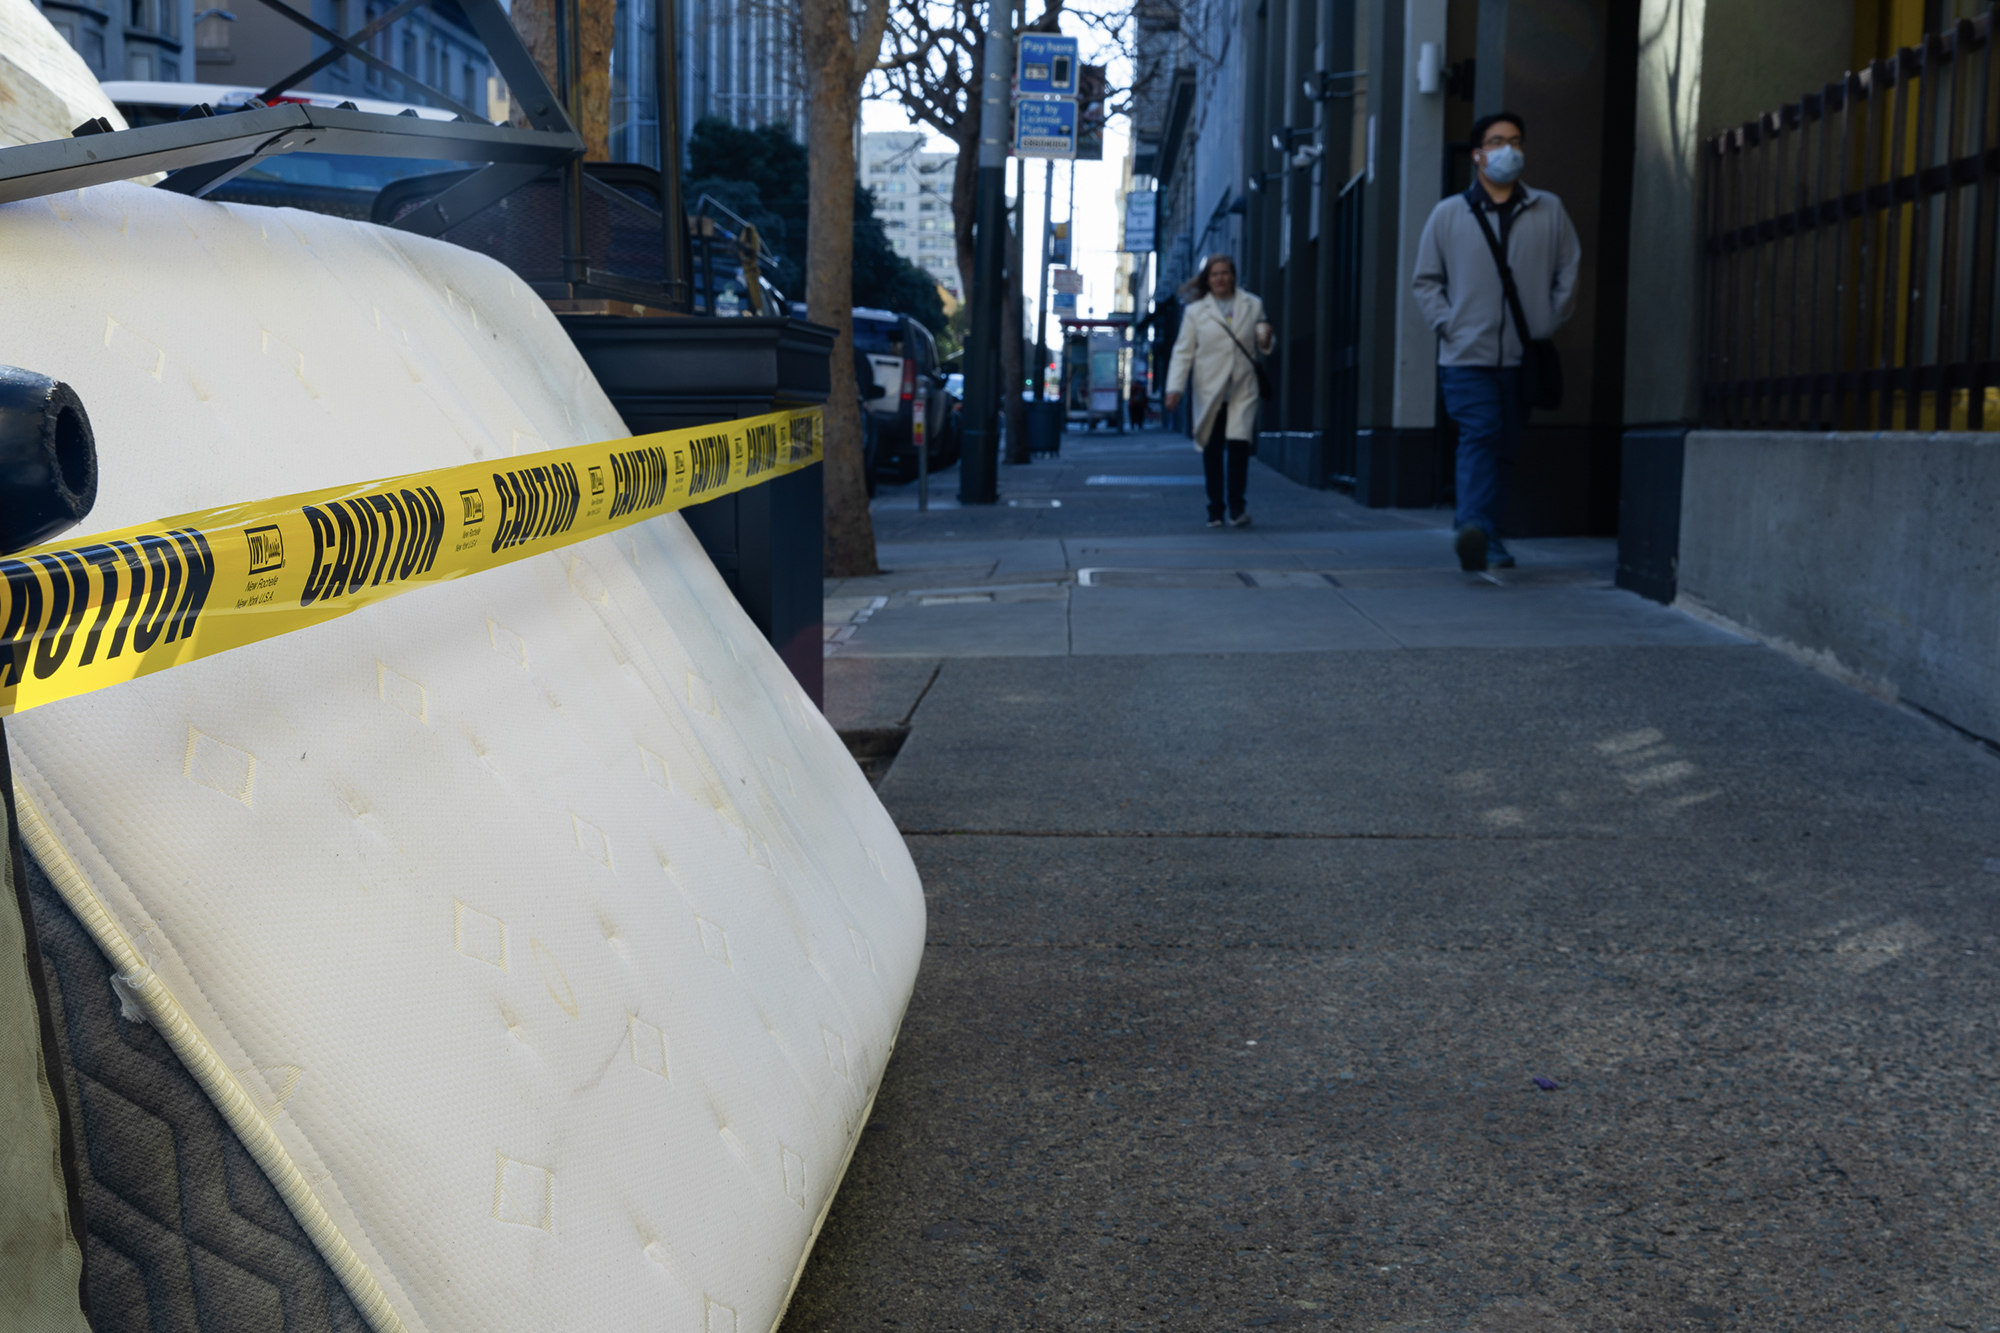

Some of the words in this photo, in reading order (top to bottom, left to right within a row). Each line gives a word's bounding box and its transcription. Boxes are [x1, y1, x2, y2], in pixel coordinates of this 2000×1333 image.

[1023, 40, 1045, 55] Pay
[1047, 41, 1074, 53] here
[1022, 102, 1041, 115] Pay
[1045, 104, 1058, 116] by
[688, 434, 730, 497] CAUTION
[746, 423, 777, 478] CAUTION
[492, 462, 580, 554] CAUTION
[608, 446, 667, 520] CAUTION
[300, 486, 445, 607] CAUTION
[235, 598, 248, 610] New
[245, 581, 258, 592] New
